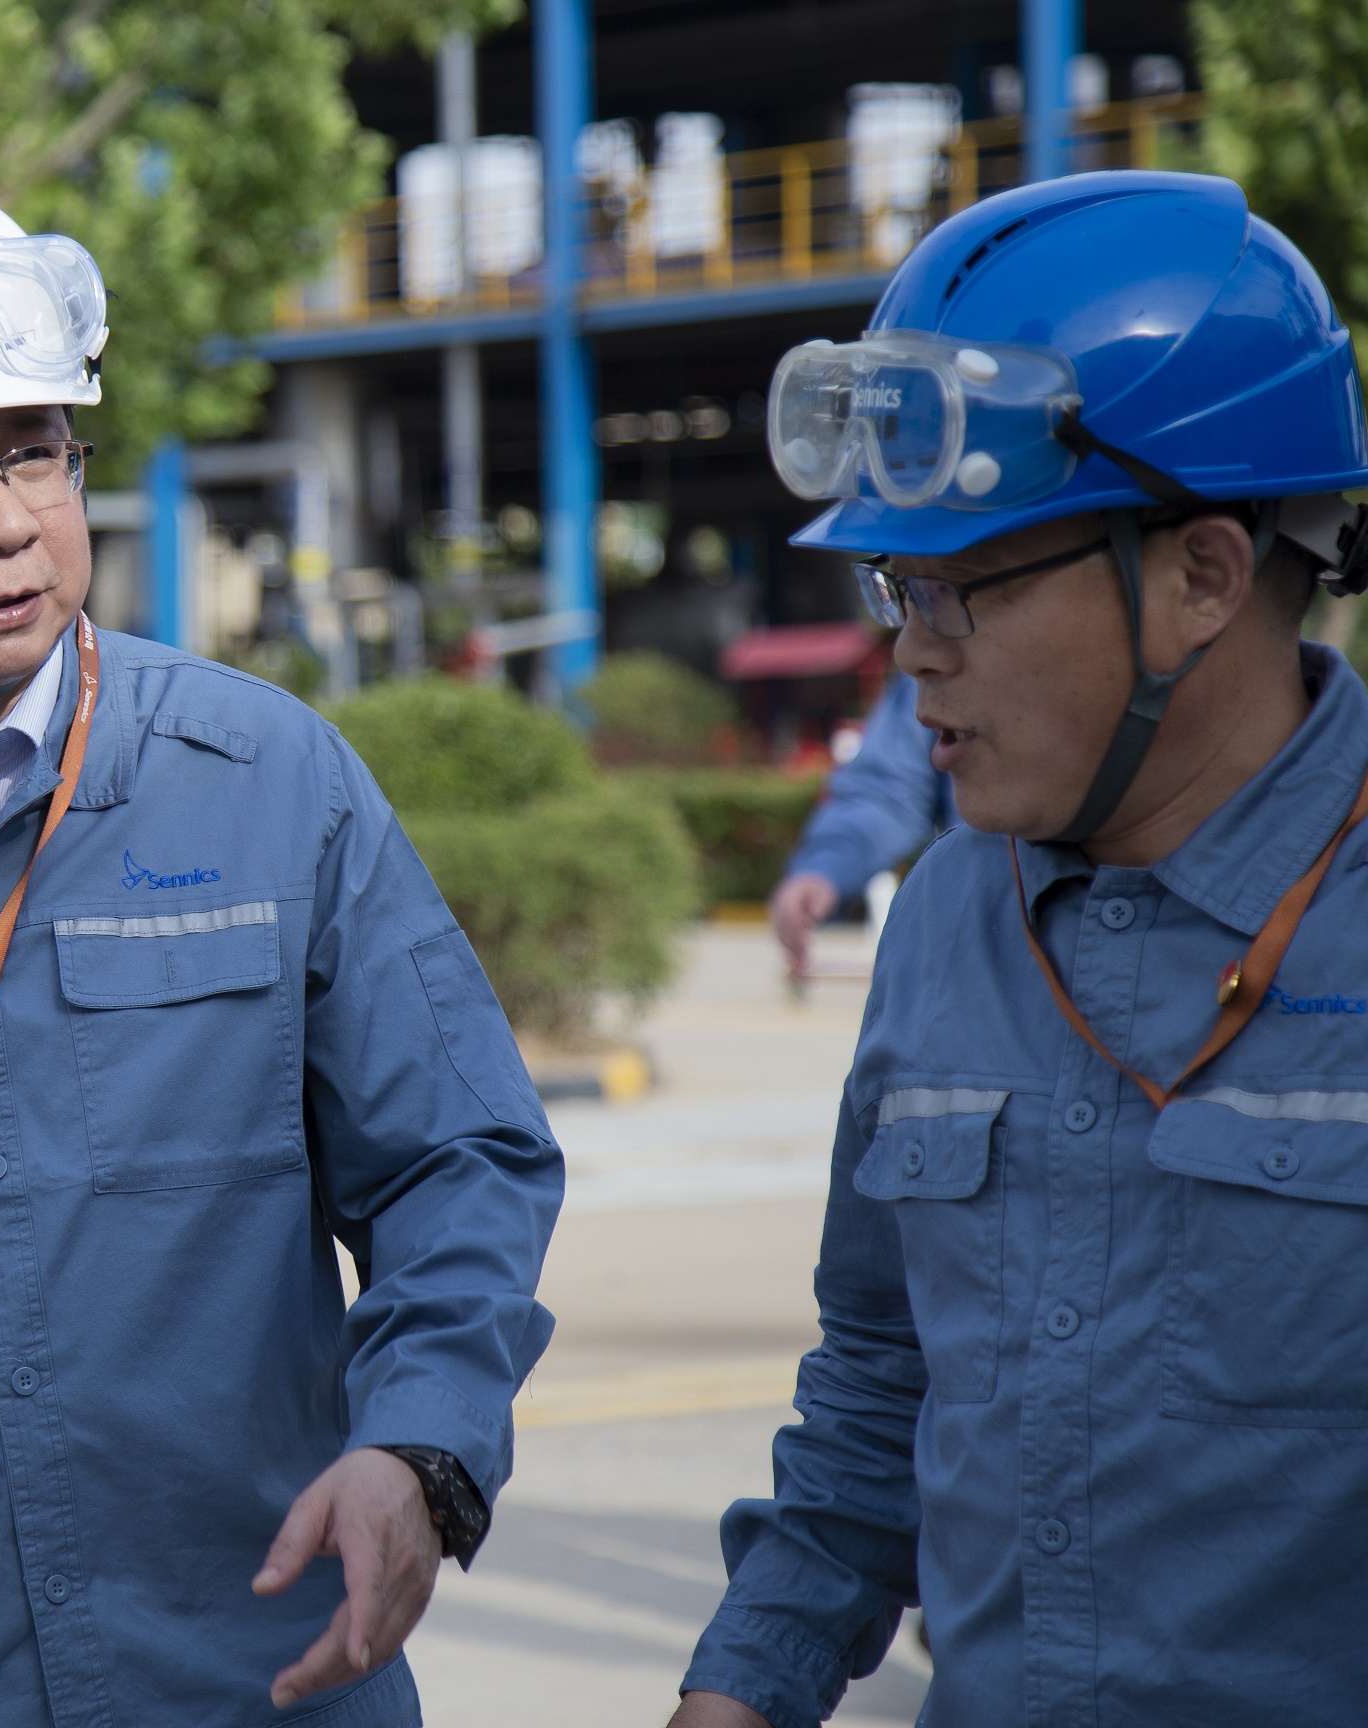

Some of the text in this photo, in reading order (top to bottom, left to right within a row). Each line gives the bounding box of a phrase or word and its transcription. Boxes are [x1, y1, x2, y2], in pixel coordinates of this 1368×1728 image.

[80, 688, 92, 723] Sennics
[148, 868, 221, 890] Sennics
[1281, 993, 1366, 1015] Sennics
